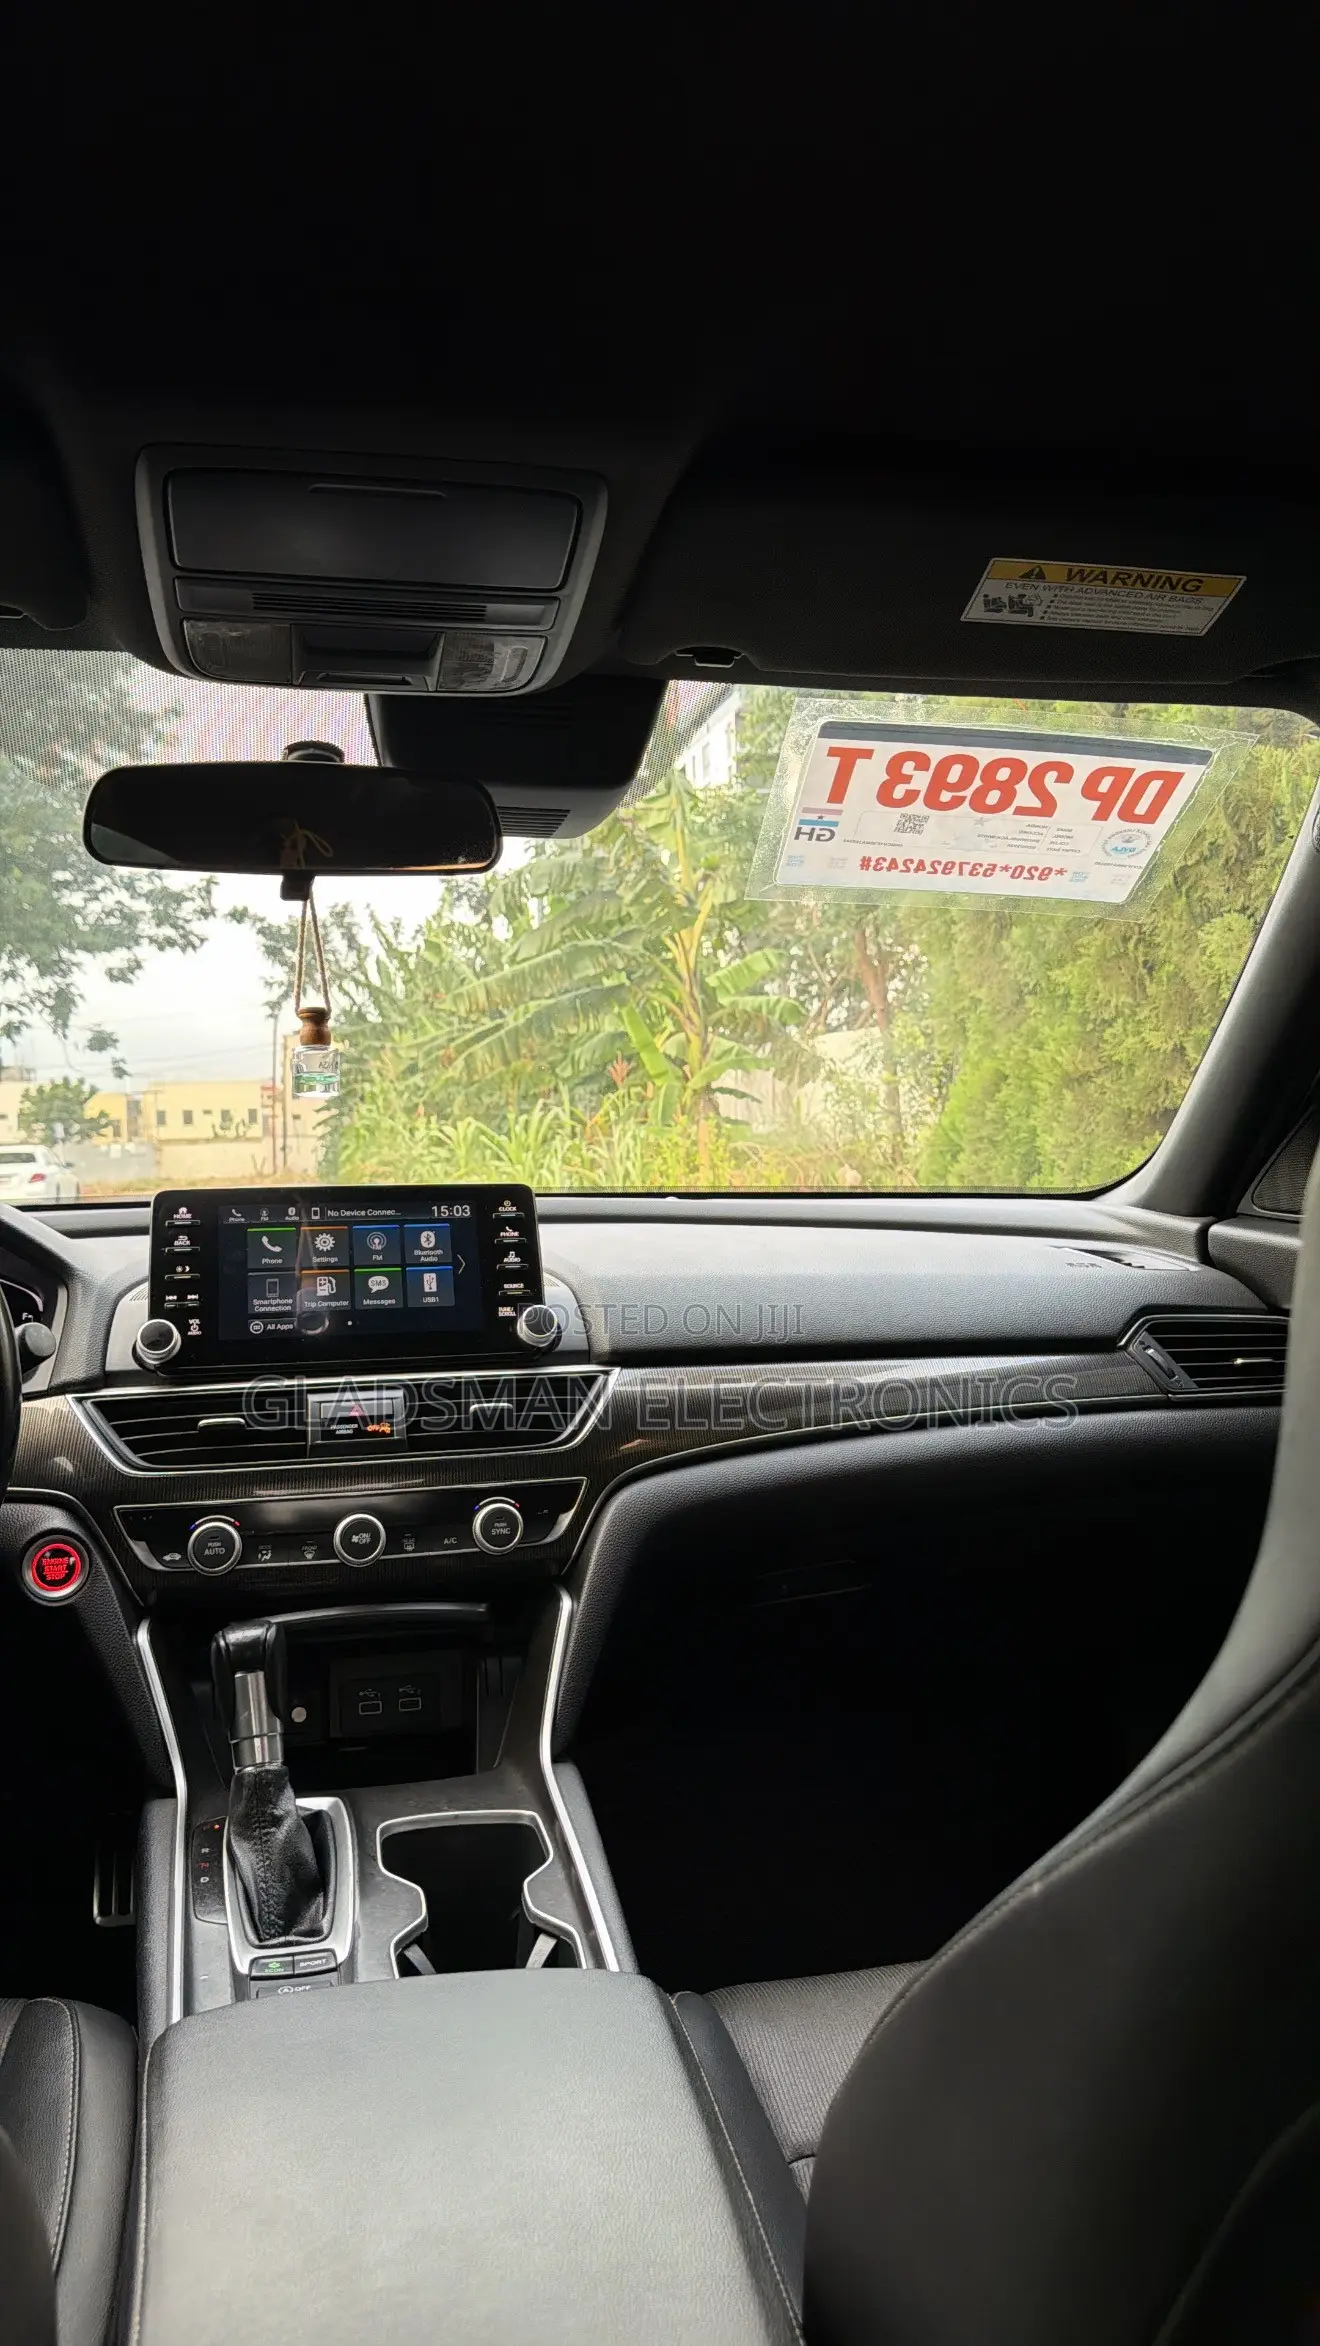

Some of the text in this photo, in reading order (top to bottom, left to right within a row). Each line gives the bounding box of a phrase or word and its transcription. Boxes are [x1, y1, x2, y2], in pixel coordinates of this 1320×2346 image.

[1065, 567, 1205, 593] WARNING
[1005, 582, 1039, 591] EVEN
[1042, 585, 1076, 594] WITH
[1078, 587, 1144, 600] ADVANCED
[1145, 594, 1167, 602] AIR
[1169, 595, 1204, 604] BAGS
[431, 1204, 471, 1217] 15:03
[370, 1279, 387, 1287] SMS
[253, 1298, 293, 1306] Smartphone
[318, 1300, 350, 1308] Computer
[363, 1298, 396, 1307] Messages
[277, 1323, 294, 1332] Apps
[443, 1537, 458, 1545] A/C
[203, 1547, 226, 1556] AUTO
[299, 1958, 327, 1967] SPORT
